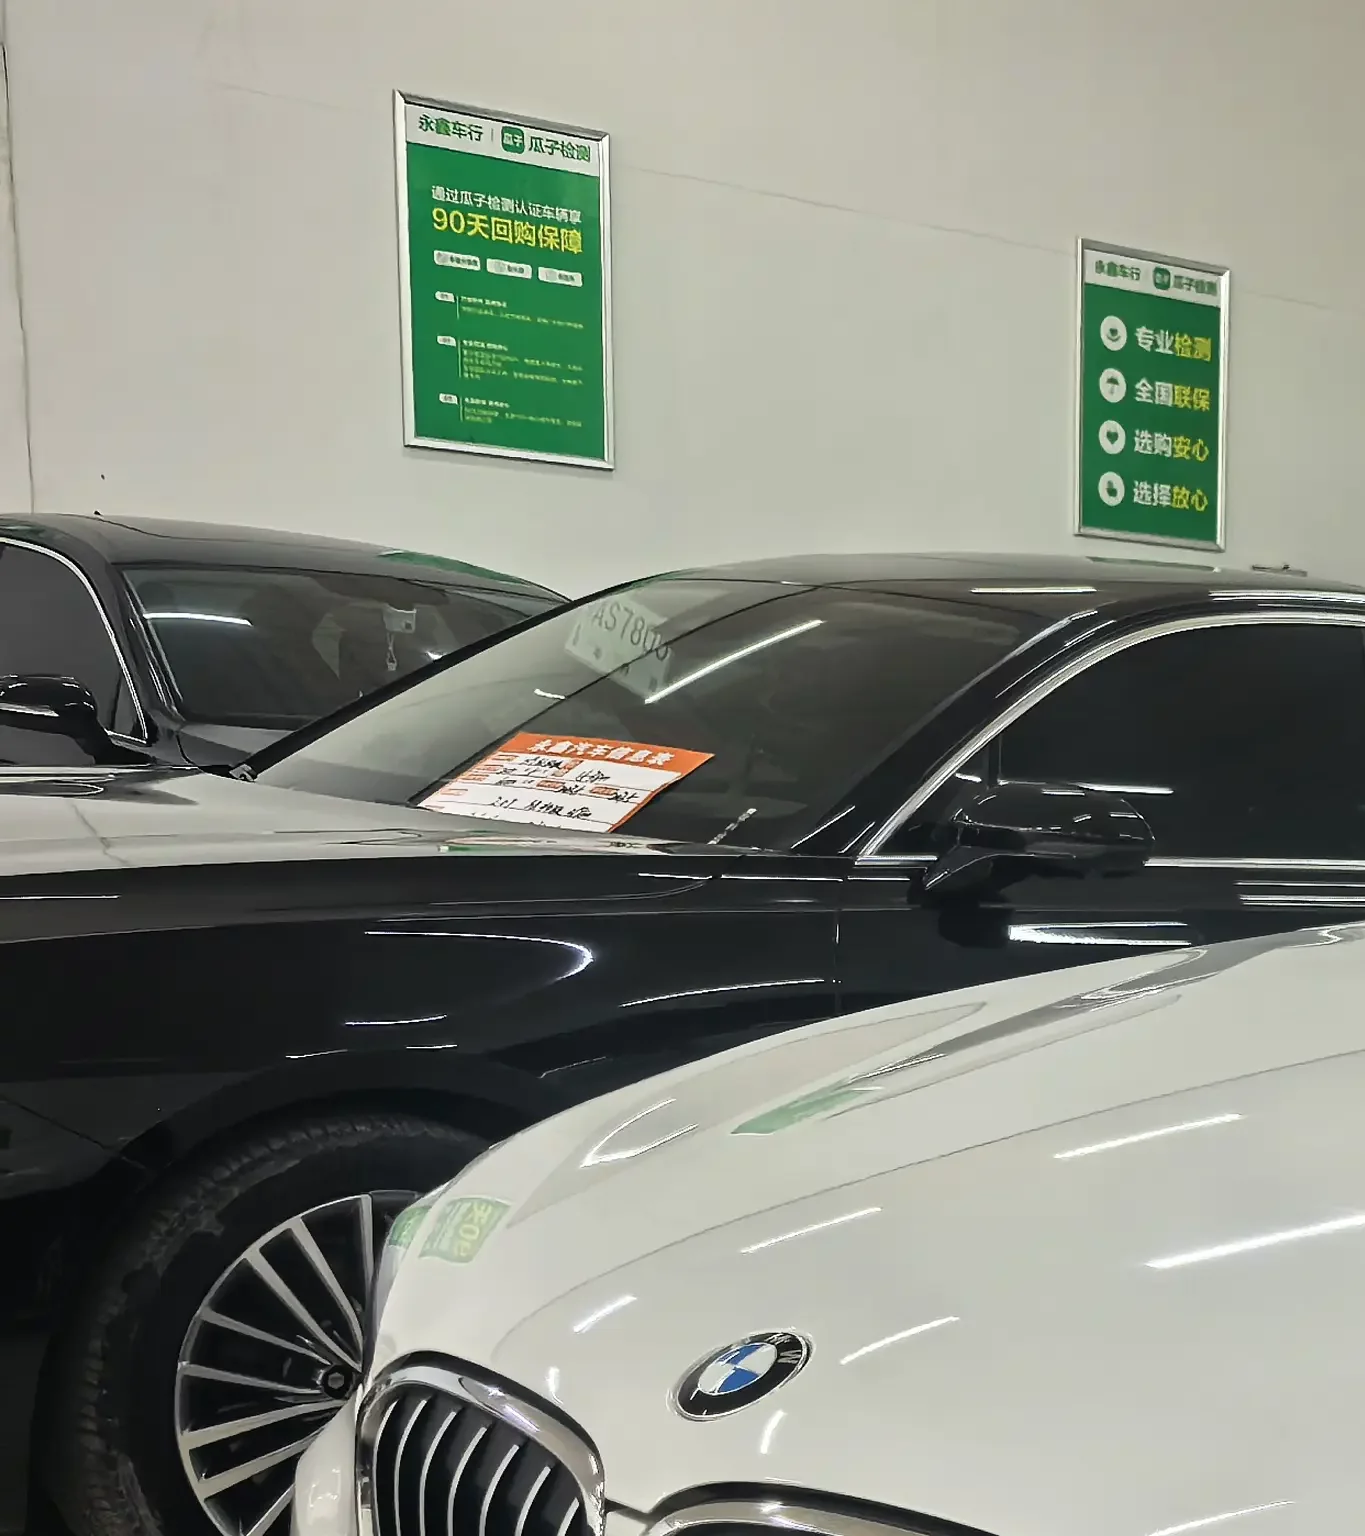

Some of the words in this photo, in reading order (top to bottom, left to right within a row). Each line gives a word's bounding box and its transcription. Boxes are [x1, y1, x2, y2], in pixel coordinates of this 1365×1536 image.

[529, 136, 591, 162] 瓜子检测
[432, 207, 583, 254] 90天回购保障
[1134, 325, 1212, 362] 专业检测
[1134, 377, 1210, 412] 全国联保
[1133, 429, 1209, 463] 选购安心
[1133, 480, 1208, 512] 选择放心
